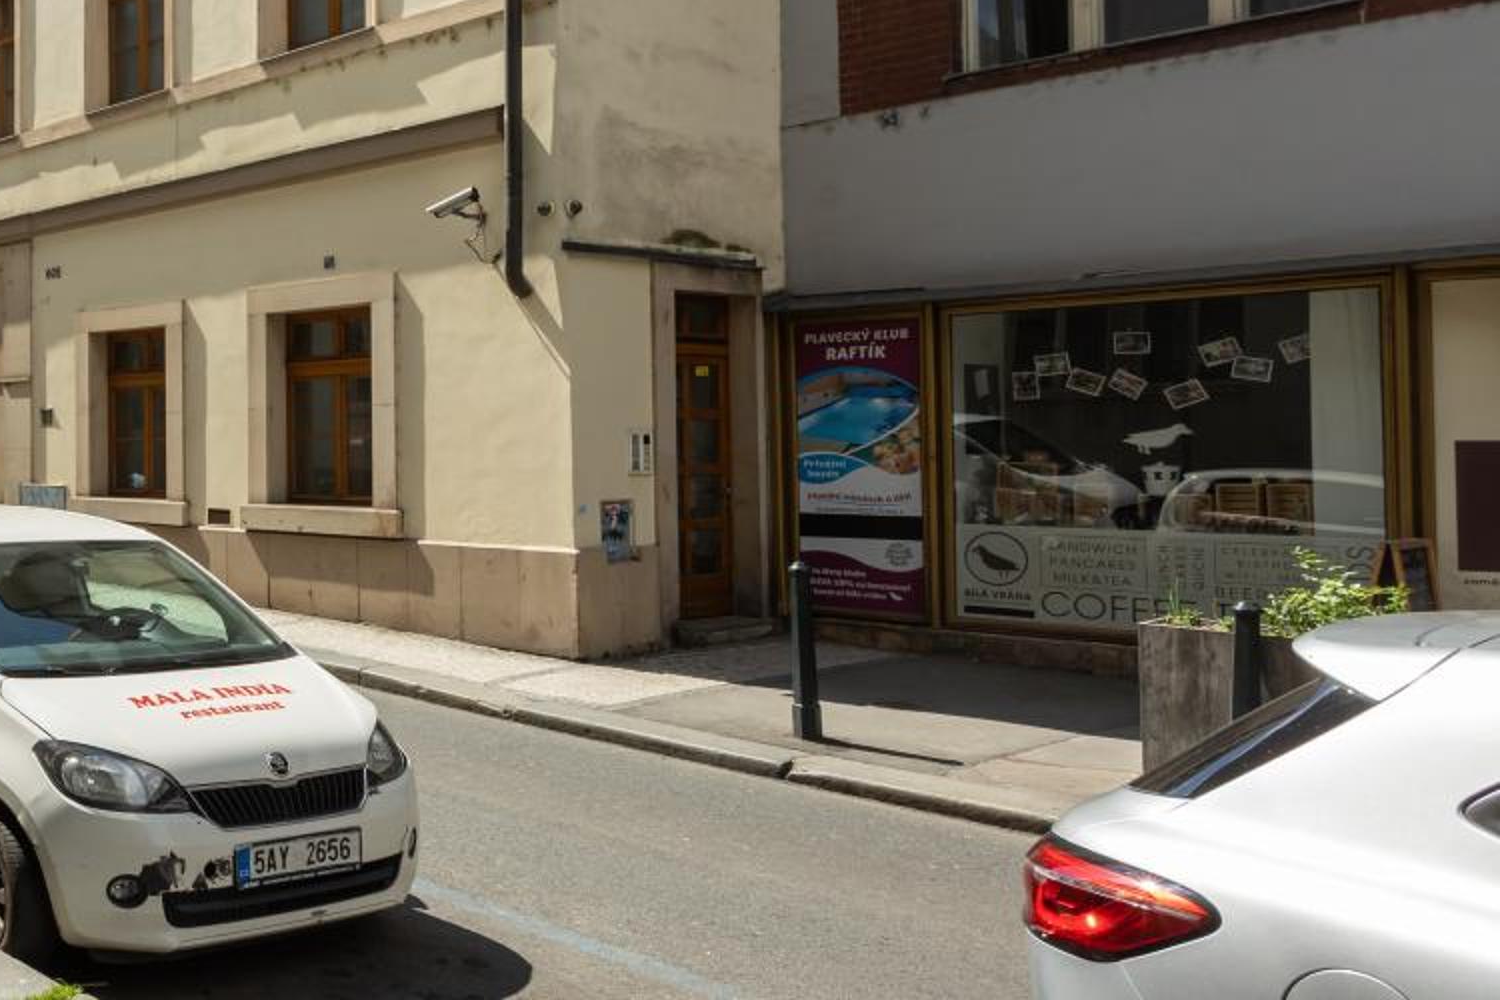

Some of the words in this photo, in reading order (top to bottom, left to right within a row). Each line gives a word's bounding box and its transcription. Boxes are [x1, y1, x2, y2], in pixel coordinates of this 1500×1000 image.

[804, 328, 870, 344] PLAVECKÝ
[873, 327, 910, 341] KLUB
[825, 342, 887, 360] RAFTÍK
[1041, 590, 1197, 623] COFFE
[127, 688, 213, 709] MALA
[212, 683, 291, 699] INDIA
[180, 701, 286, 719] restaurant
[254, 846, 290, 874] 5AY
[306, 837, 352, 866] 2656
